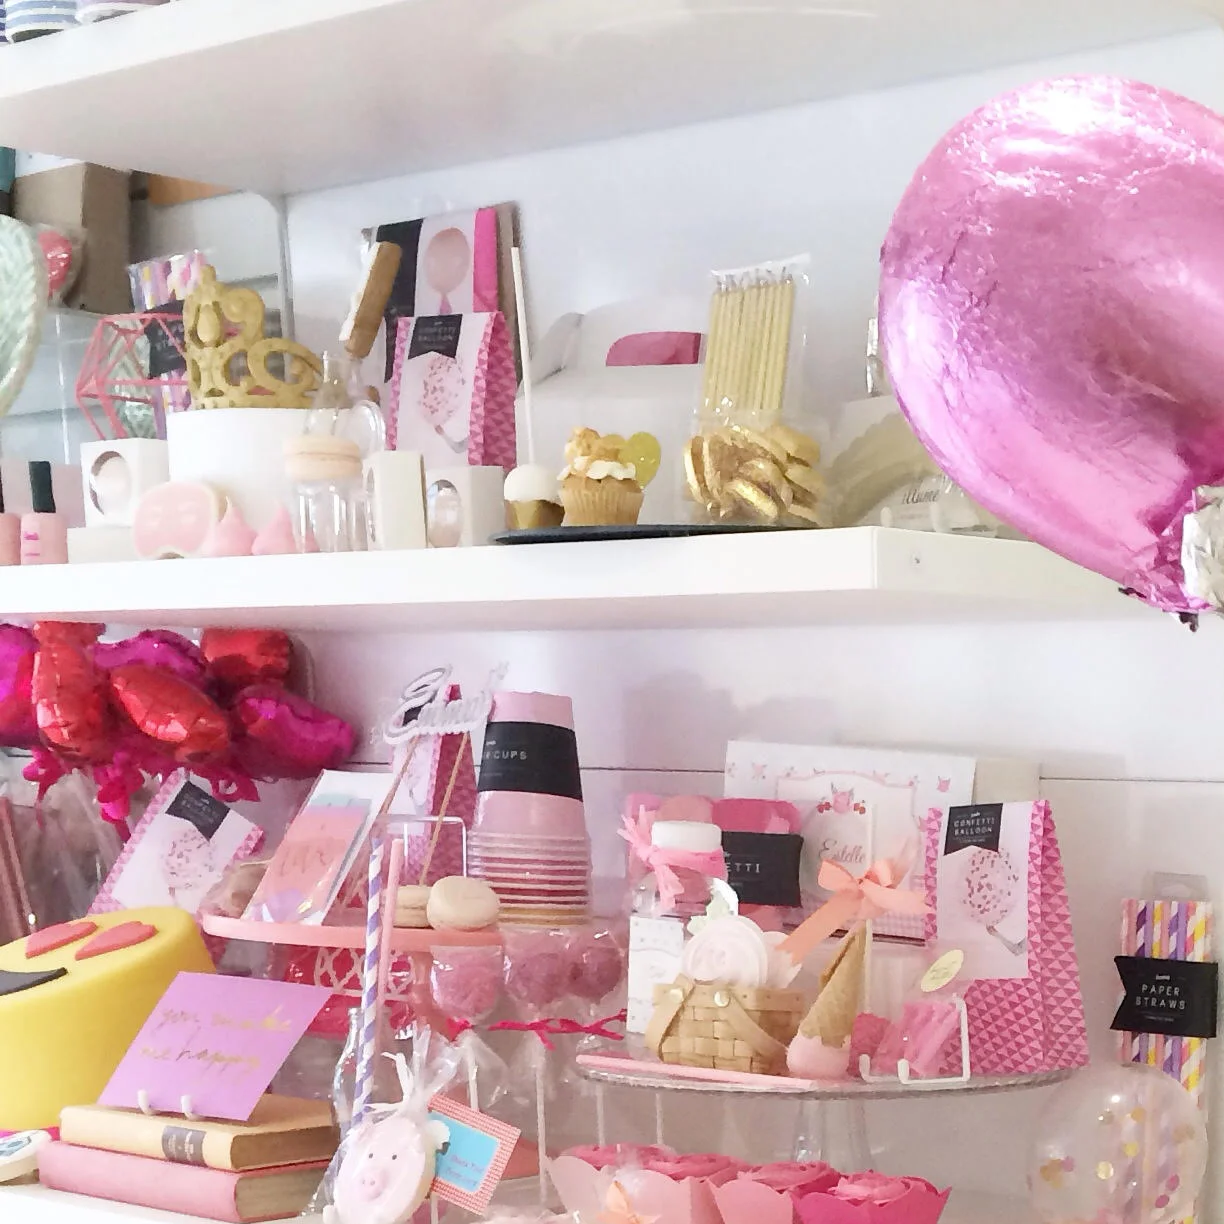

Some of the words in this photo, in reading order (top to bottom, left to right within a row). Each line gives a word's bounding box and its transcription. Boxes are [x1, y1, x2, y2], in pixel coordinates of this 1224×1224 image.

[493, 750, 527, 761] CUPS
[953, 816, 995, 828] CONFETTI
[954, 826, 993, 836] BALLOON
[818, 837, 867, 864] Estelle
[726, 861, 761, 874] ETTI
[1141, 983, 1181, 997] PAPER
[1135, 996, 1186, 1010] STRAWS
